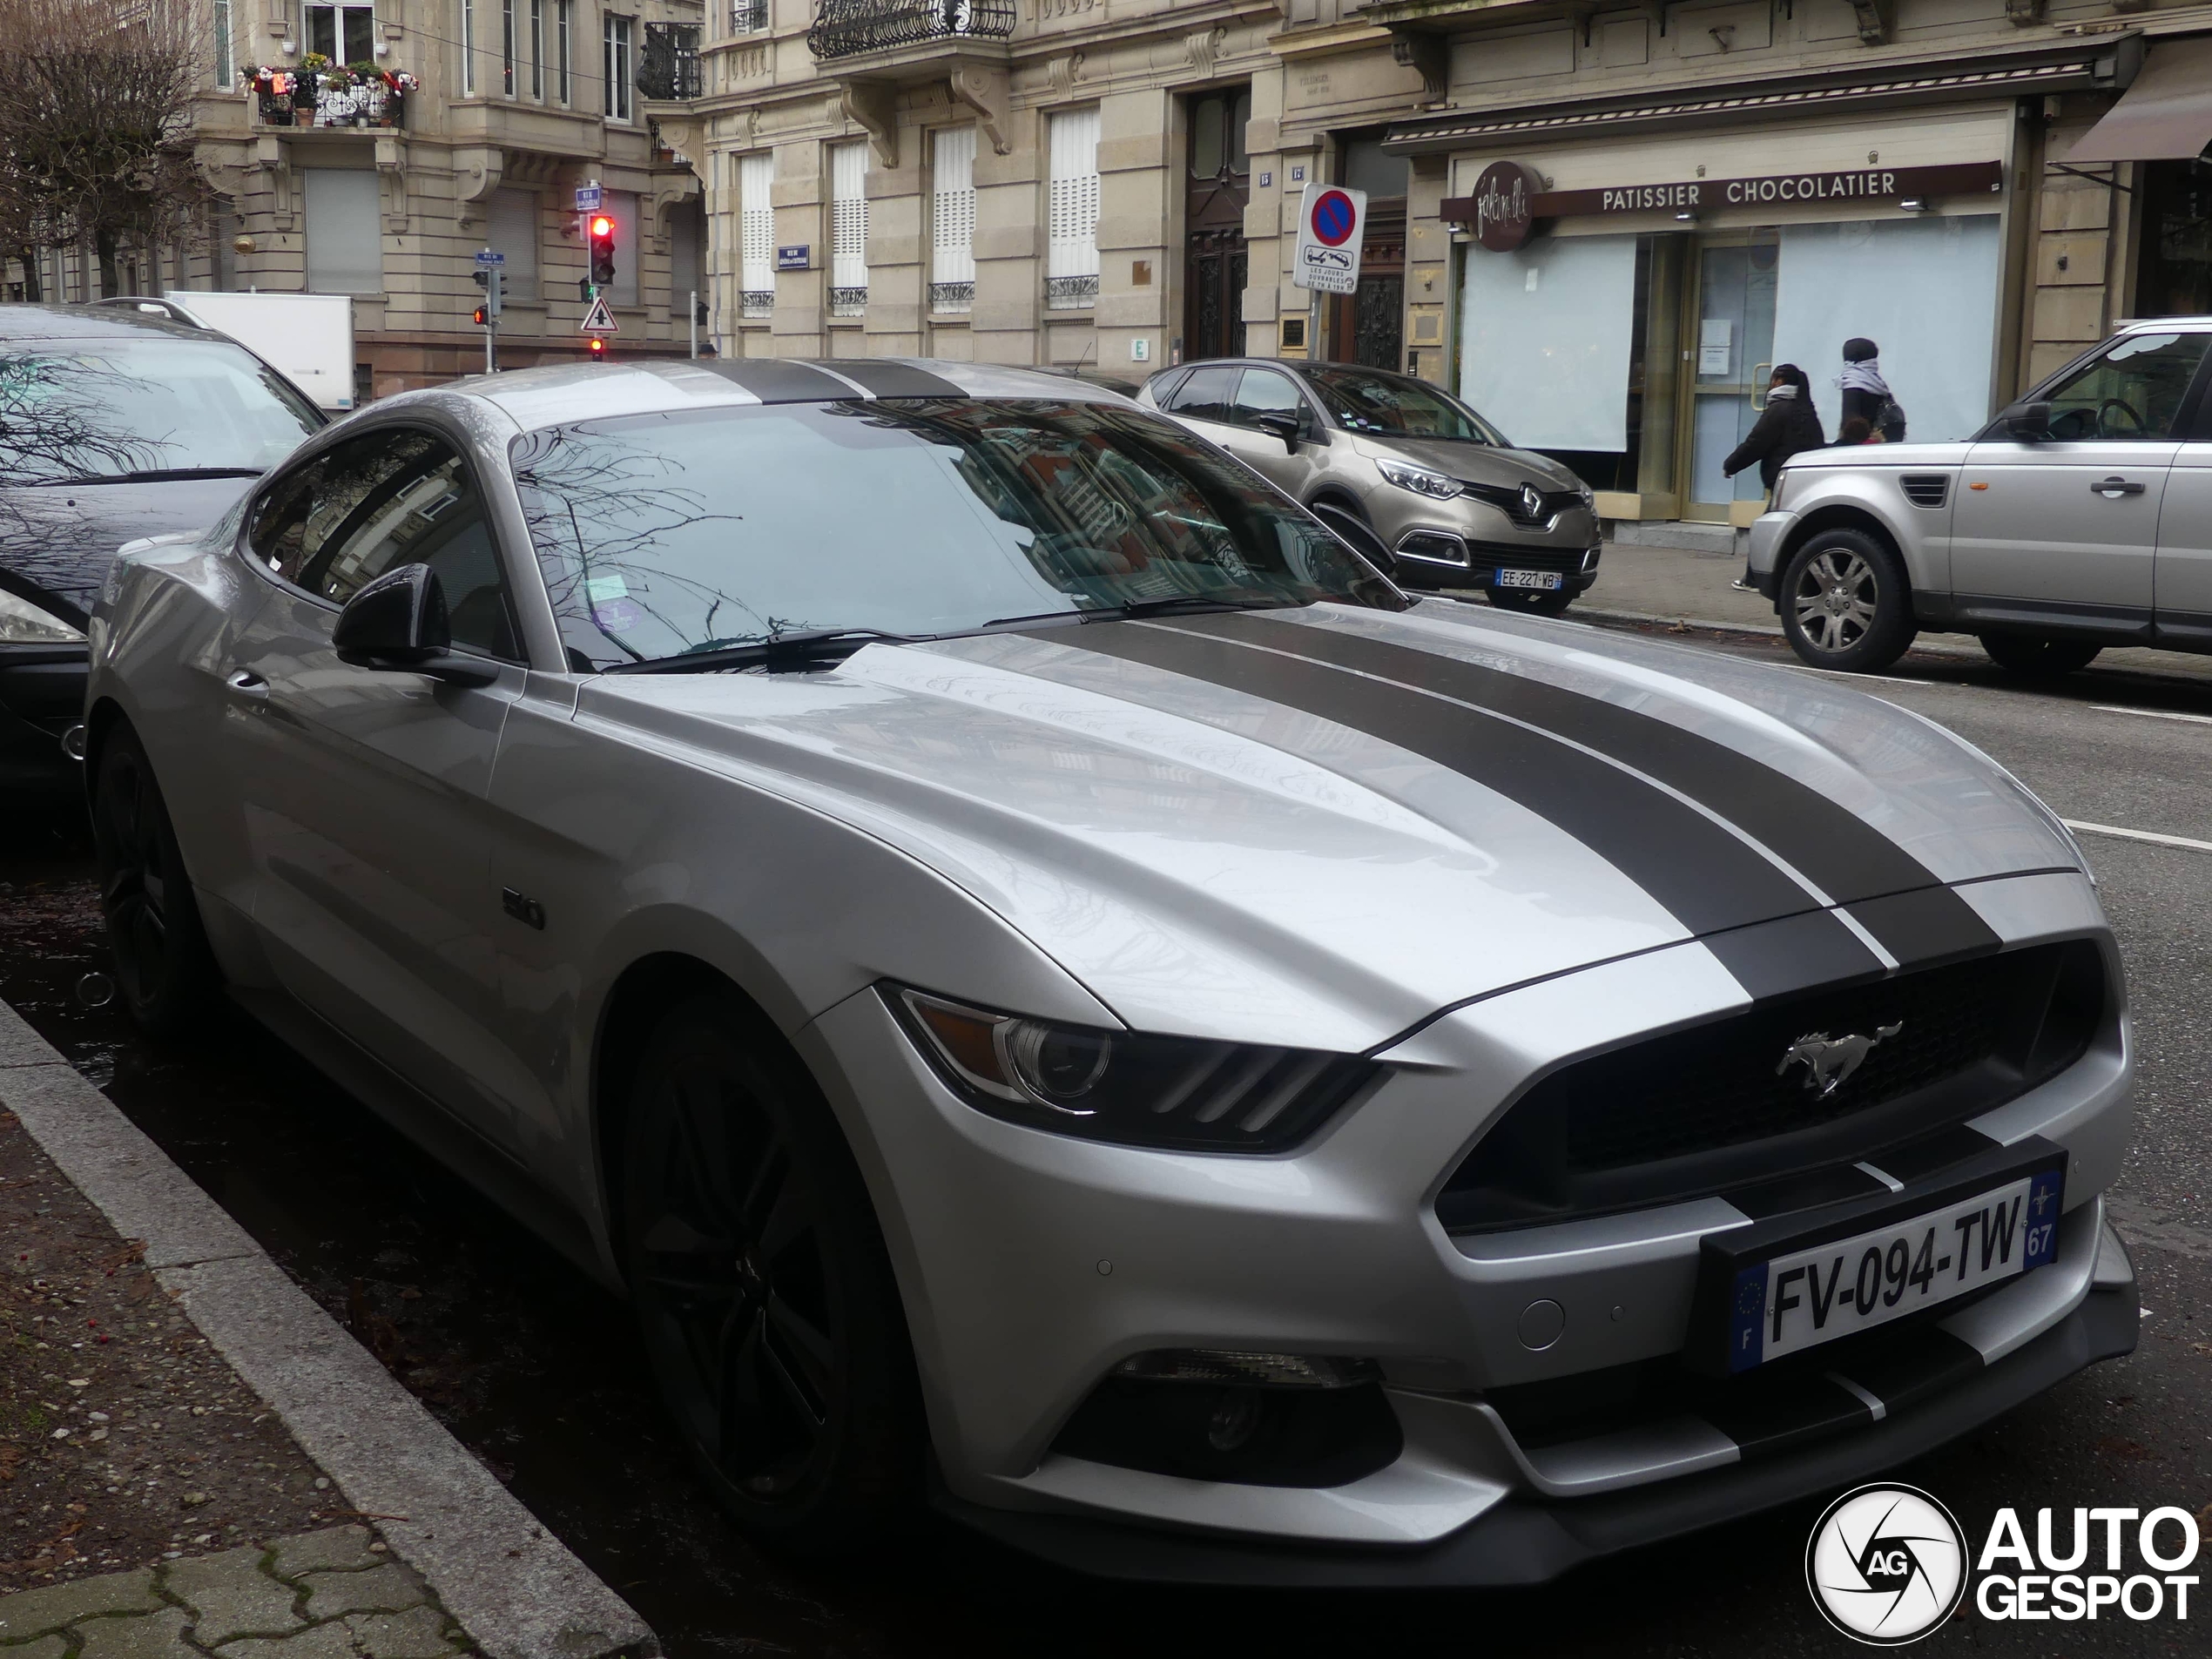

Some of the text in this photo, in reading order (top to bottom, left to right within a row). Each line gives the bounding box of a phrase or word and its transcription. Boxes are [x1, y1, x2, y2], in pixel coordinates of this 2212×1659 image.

[1261, 174, 1269, 185] 15
[1603, 172, 1895, 212] PATISSIER CHOCOLATIER
[1309, 274, 1344, 284] OUVRABLES
[1742, 1195, 2054, 1350] F FV-094-TW 67
